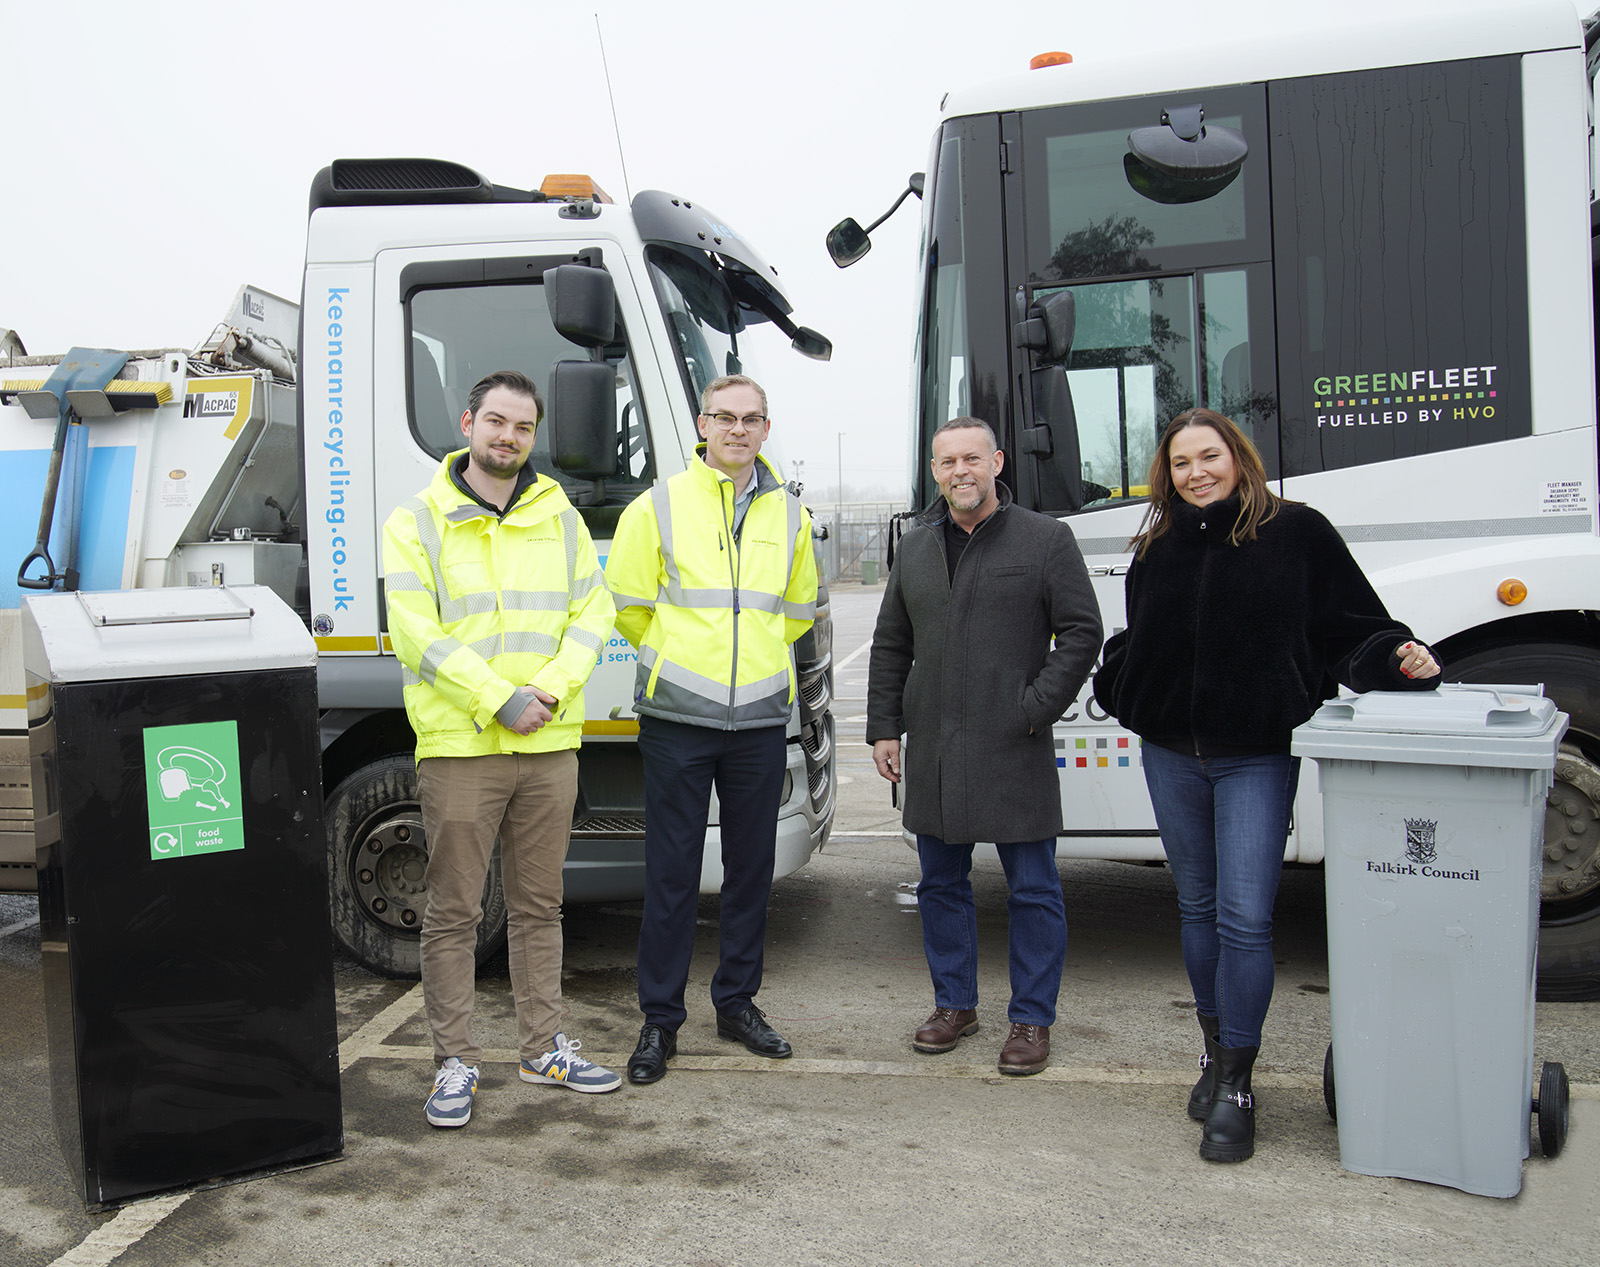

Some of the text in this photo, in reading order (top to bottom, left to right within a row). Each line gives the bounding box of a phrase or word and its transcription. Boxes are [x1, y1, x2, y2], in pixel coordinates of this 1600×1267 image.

[1314, 366, 1497, 395] GREENFLEET
[183, 393, 236, 418] MACPAC
[1317, 406, 1495, 427] FUELLED BY HVO
[324, 288, 354, 611] keenanrecycling.co.uk
[195, 837, 223, 847] waste
[198, 827, 220, 838] food
[1366, 861, 1480, 881] Falkirk Council
